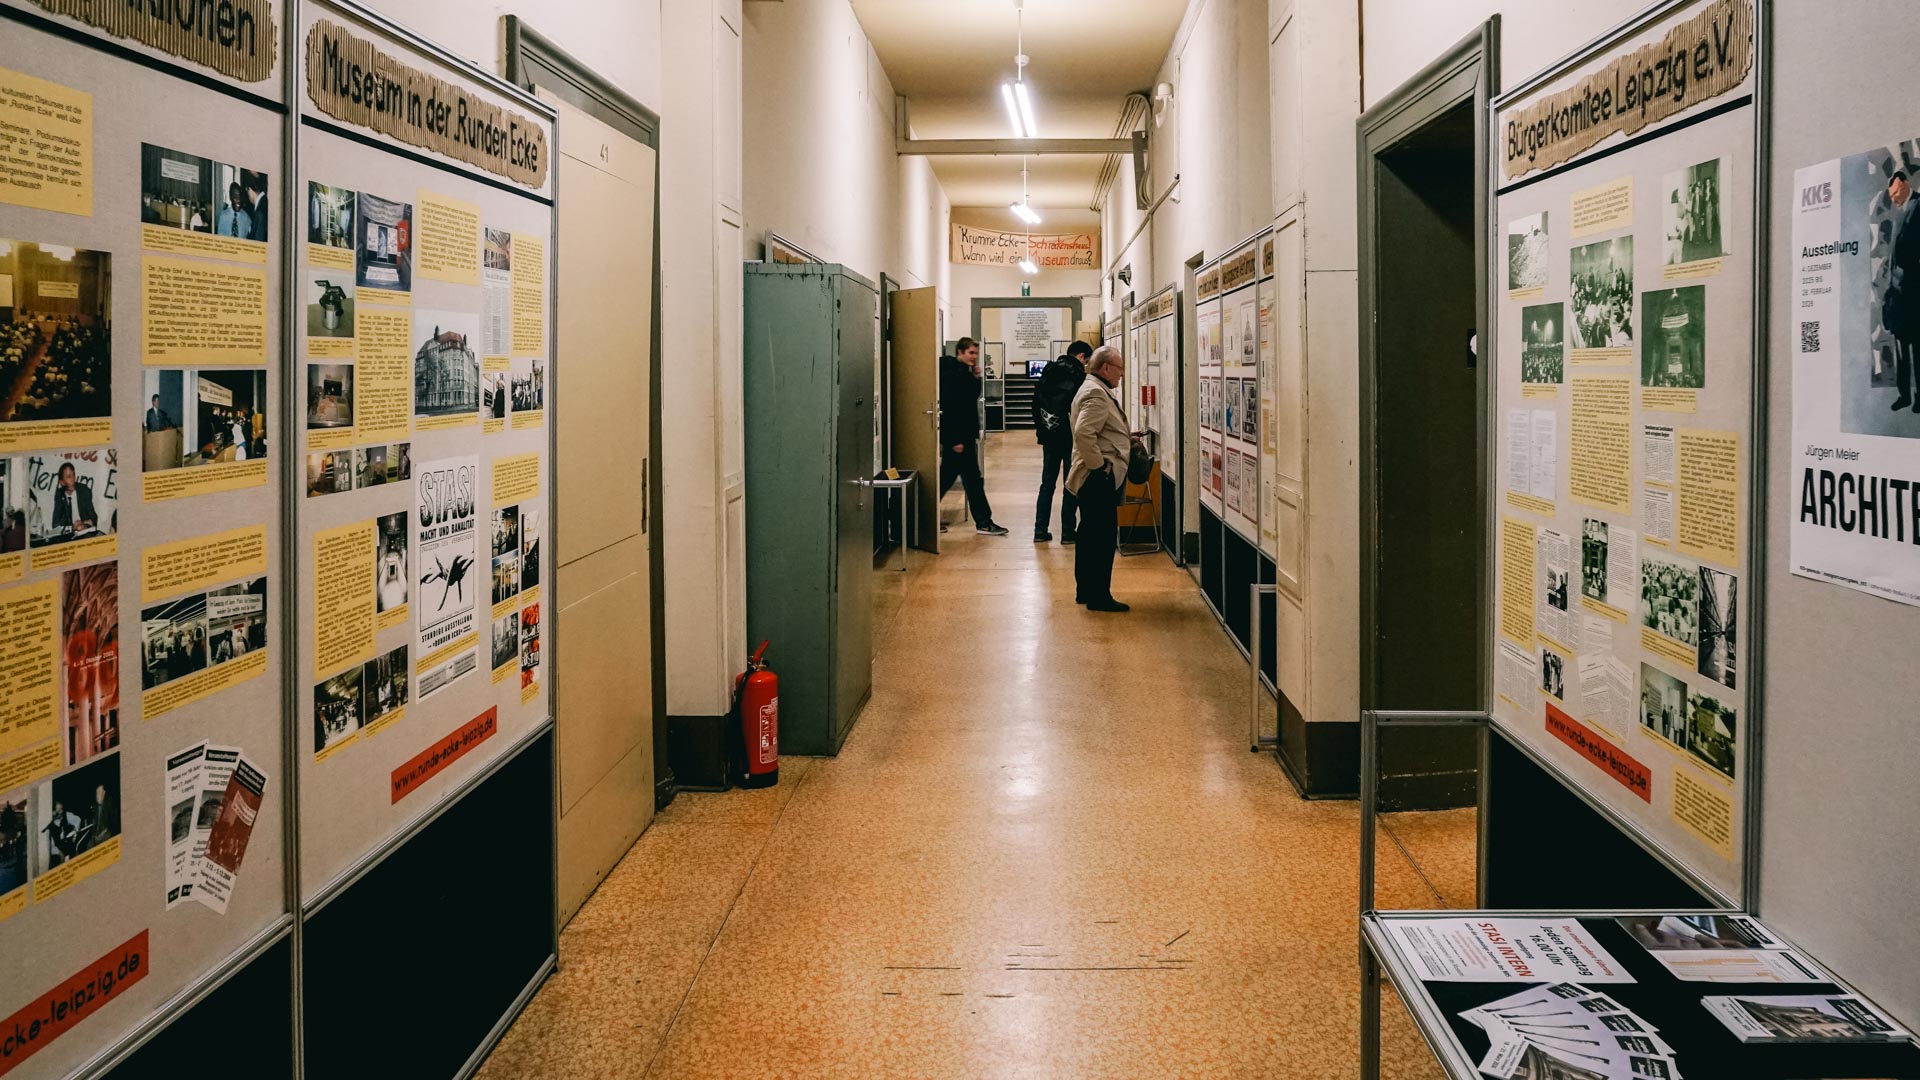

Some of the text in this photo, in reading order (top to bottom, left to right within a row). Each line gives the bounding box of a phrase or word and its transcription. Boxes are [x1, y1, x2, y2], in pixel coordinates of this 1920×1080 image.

[322, 33, 403, 120] Museum
[406, 77, 422, 129] in
[426, 86, 451, 138] der
[1507, 82, 1612, 163] Bürgerkomitee
[1615, 42, 1687, 119] Leipzig
[960, 227, 995, 248] Krumme
[960, 245, 987, 263] Wann
[988, 251, 1004, 264] wird
[1009, 251, 1023, 264] ein
[1027, 250, 1070, 267] Museum
[1801, 240, 1860, 259] Ausstellung
[1804, 444, 1861, 462] Jürgen Meier
[420, 465, 476, 528] STASI
[1800, 467, 1920, 547] ARCHITE
[420, 528, 437, 542] MACHT
[438, 525, 450, 537] UND
[394, 714, 493, 792] www.runde-ecke-leipzig.de
[1548, 713, 1647, 791] www.runde-ecke-leipzig.de
[1477, 922, 1535, 977] STASI INTERN
[1529, 934, 1564, 967] 16.00 Uhr
[1540, 925, 1594, 977] Jeden Samstag
[0, 951, 140, 1059] cke-leipzig.de
